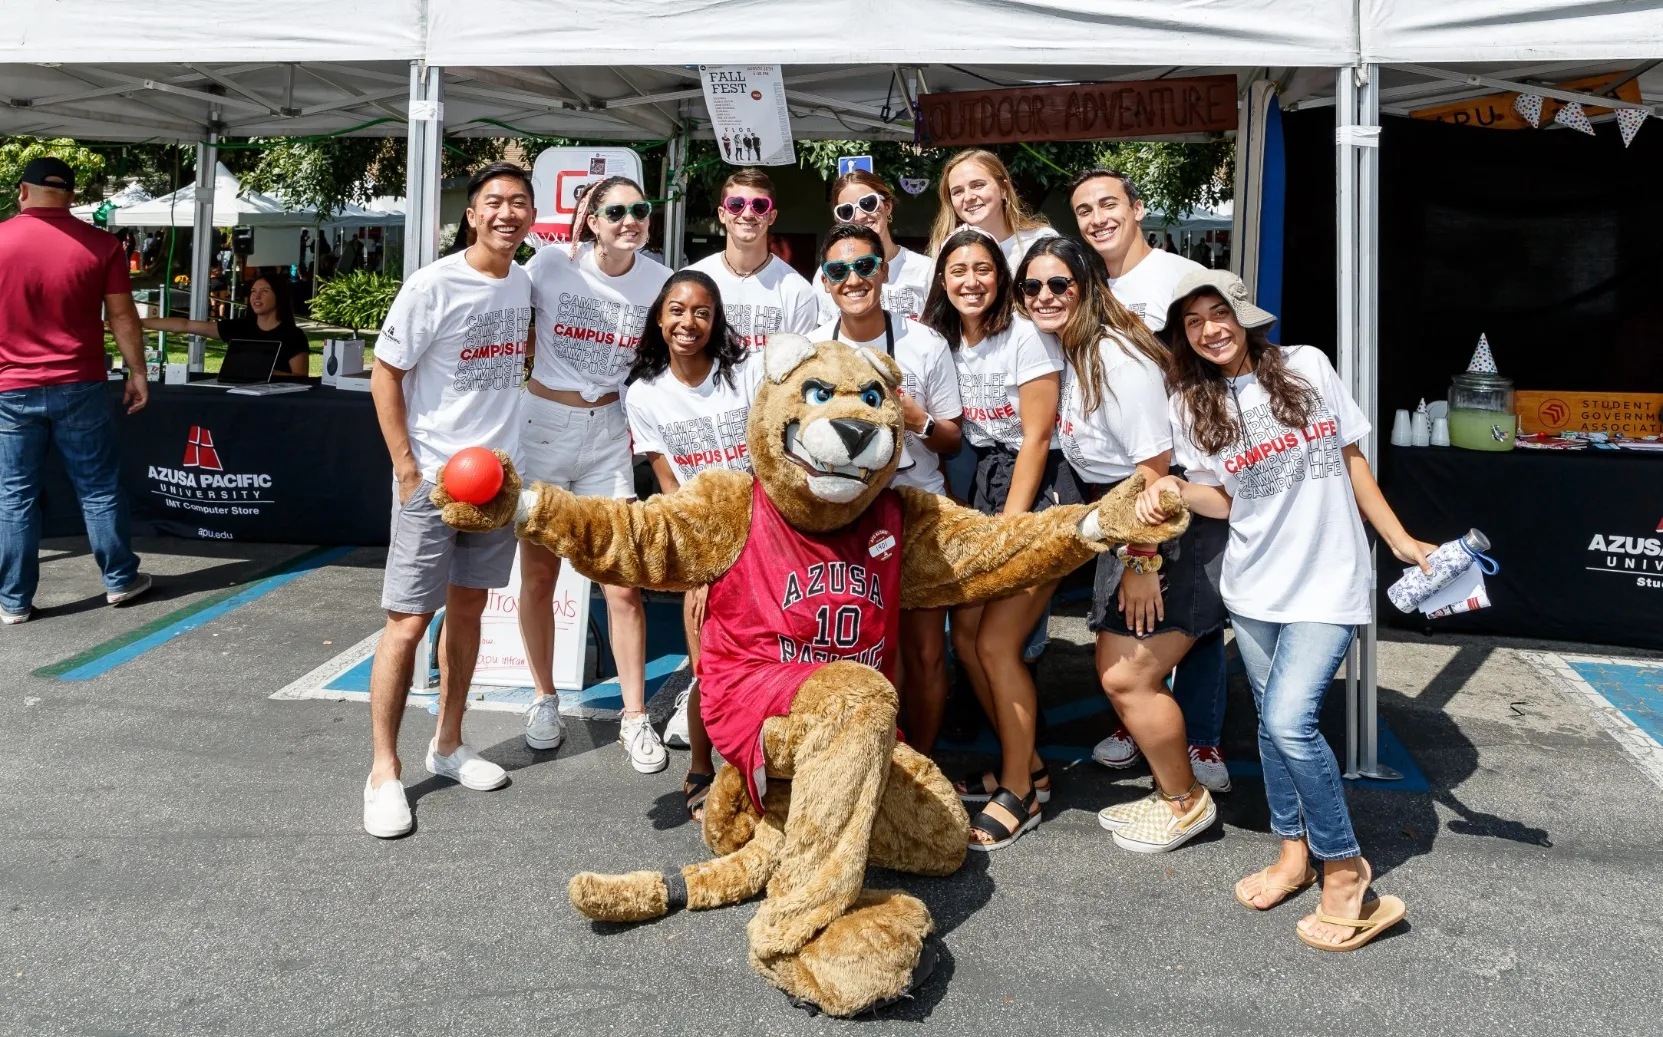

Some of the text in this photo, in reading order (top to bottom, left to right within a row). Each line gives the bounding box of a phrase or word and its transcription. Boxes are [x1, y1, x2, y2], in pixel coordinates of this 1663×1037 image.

[709, 71, 746, 82] FALL
[712, 83, 747, 94] FEST
[929, 94, 1050, 140] OUTDOOR
[1065, 84, 1227, 133] ADVENTURE
[1435, 104, 1496, 126] PU
[559, 293, 620, 314] CAMPUS
[723, 304, 751, 316] PUS
[467, 308, 515, 328] CAMPUS
[557, 303, 619, 325] CAMPUS
[555, 314, 617, 334] CAMPUS
[552, 335, 612, 354] CAMPUS
[554, 324, 642, 348] CAMPUS LIF
[755, 335, 766, 346] LI
[460, 343, 514, 360] CAMPUS
[457, 355, 513, 371] CAMPUS
[453, 377, 509, 391] CAMPUS
[963, 403, 1016, 421] PUS LIFE
[1583, 400, 1651, 409] STUDENT
[657, 407, 748, 435] CAMPUS LIFE
[1581, 411, 1655, 421] GOVERNM
[721, 433, 747, 448] LIF
[1224, 421, 1337, 474] CAMPUS LIFE
[1308, 436, 1338, 452] LIFE
[724, 444, 747, 460] LIF
[1309, 448, 1340, 466] LIFE
[148, 466, 273, 488] AZUSA PACIFIC
[1311, 461, 1341, 479] LIFE
[160, 483, 260, 499] UNIVERSITY
[165, 499, 259, 515] IMT Computer Store
[198, 528, 233, 539] apu.edu
[782, 561, 884, 610] AZUSA
[1636, 577, 1663, 588] Stu
[812, 604, 861, 649] 10
